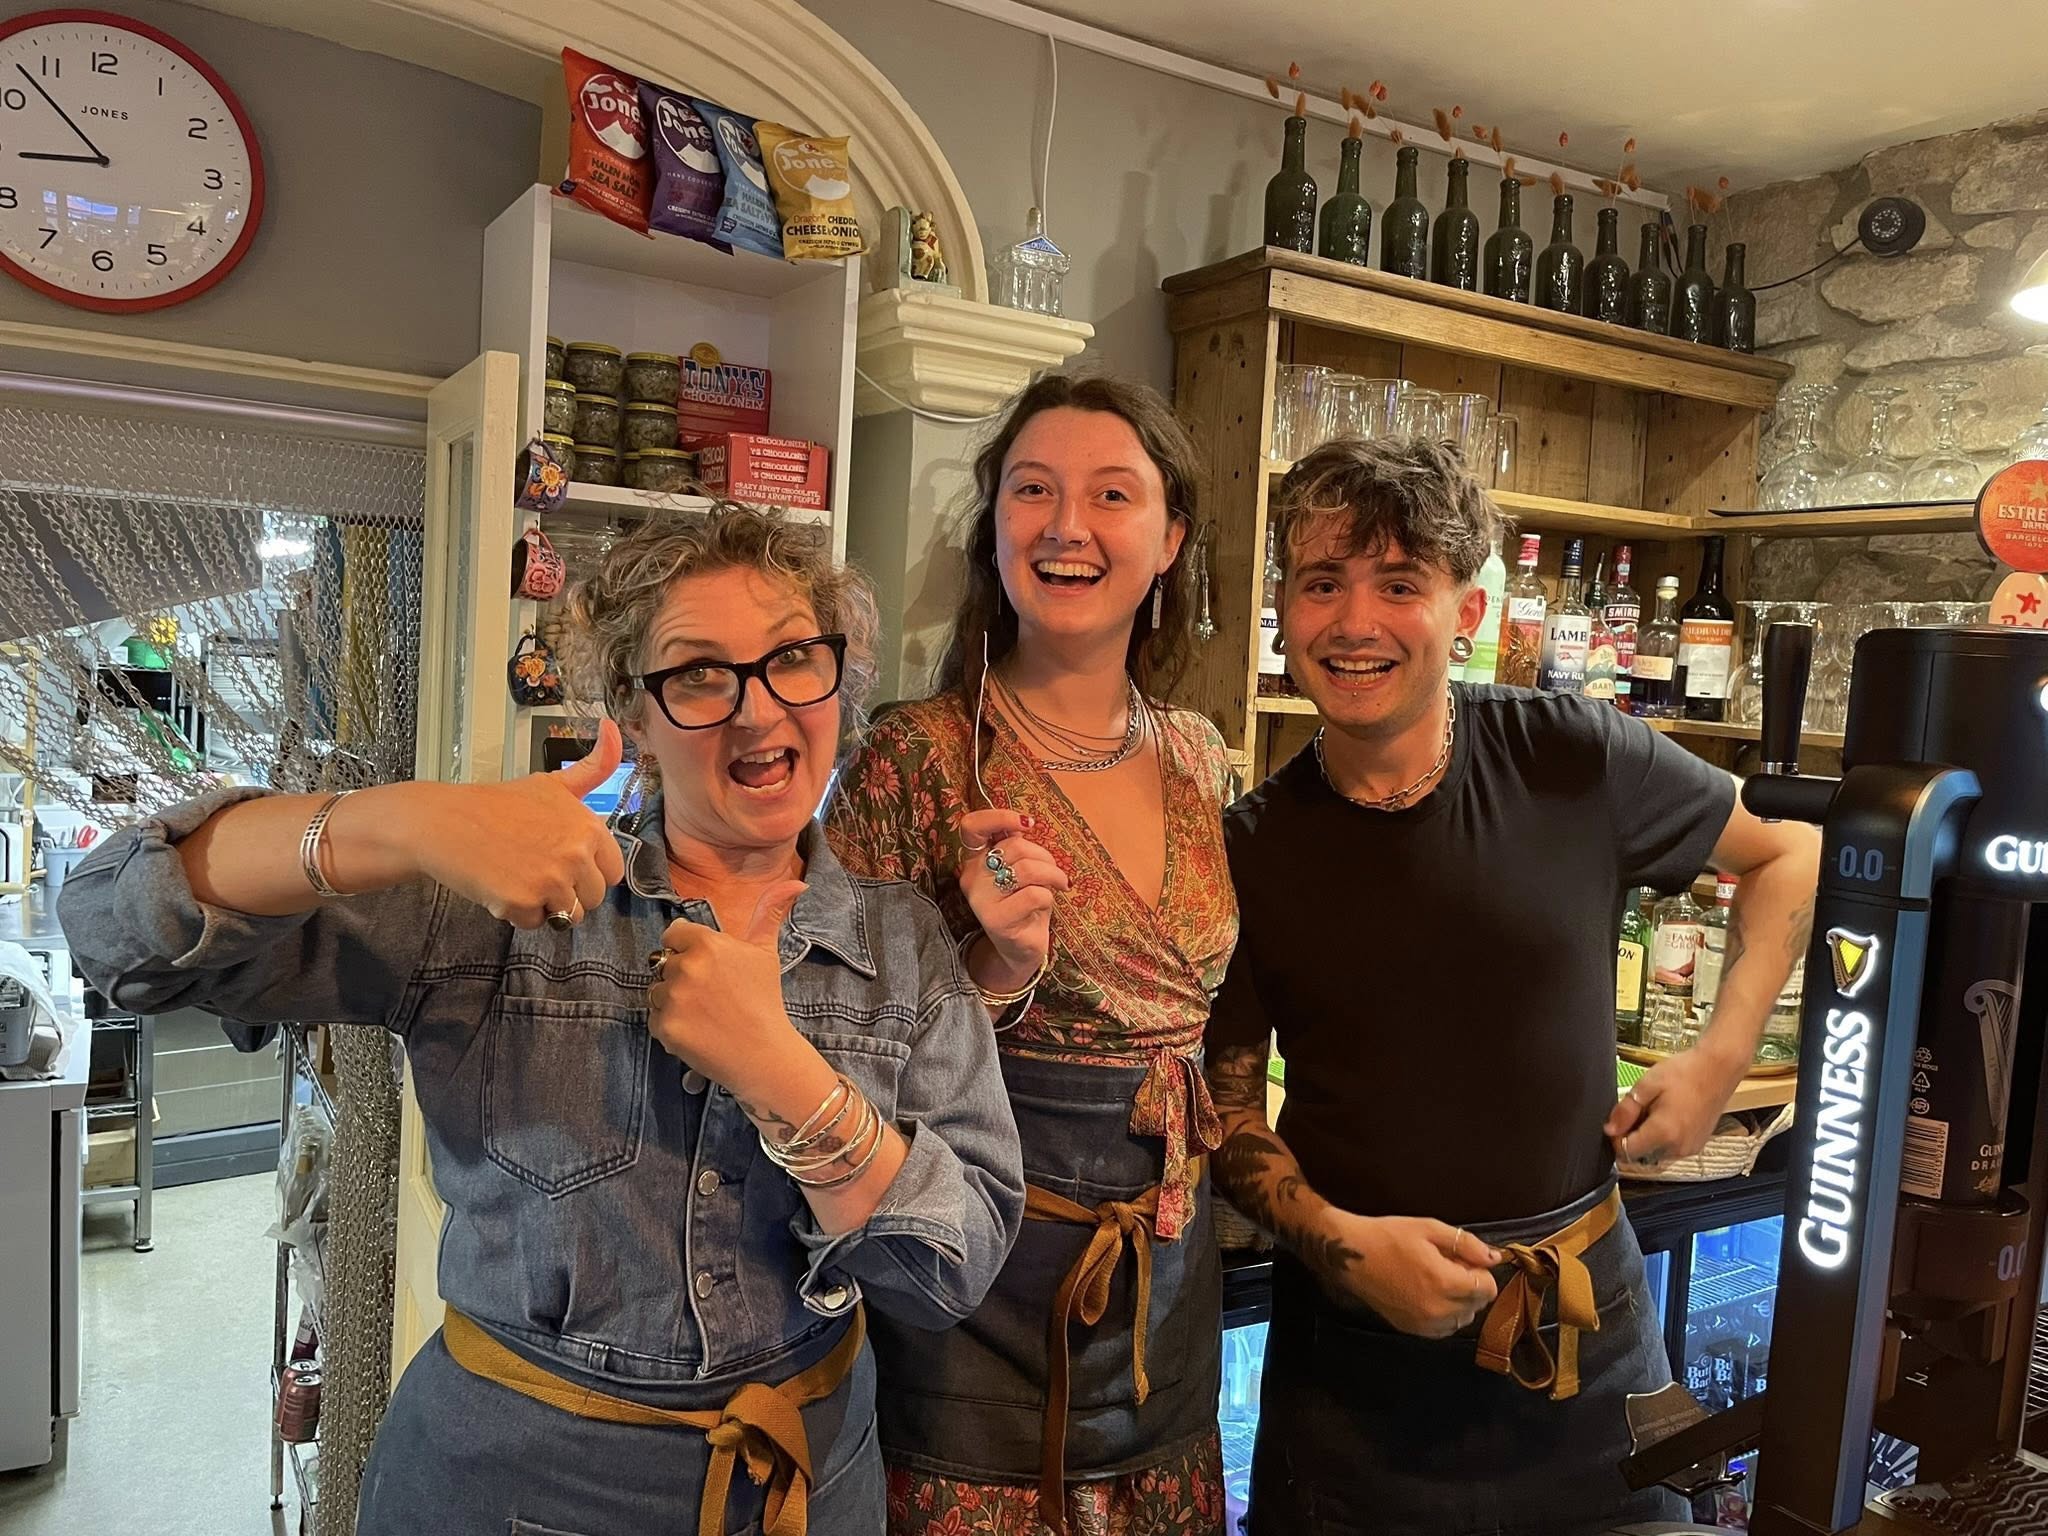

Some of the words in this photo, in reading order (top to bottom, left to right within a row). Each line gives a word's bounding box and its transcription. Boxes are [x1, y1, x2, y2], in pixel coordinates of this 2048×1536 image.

[42, 55, 60, 78] 11
[92, 51, 118, 75] 12
[158, 77, 163, 96] 1
[81, 105, 129, 121] JONES
[587, 93, 642, 123] Jone
[187, 118, 208, 140] 2
[203, 169, 223, 190] 3
[591, 169, 610, 188] SEA
[611, 181, 638, 201] SALT
[0, 187, 19, 209] 8
[186, 216, 207, 236] 4
[786, 225, 827, 236] CHEESE
[38, 228, 58, 249] 7
[91, 250, 114, 272] 6
[147, 244, 167, 265] 5
[682, 388, 766, 410] CHOCOLONELY
[734, 482, 758, 491] CRAZY
[734, 489, 766, 499] SERIOUS
[1998, 504, 2047, 522] ESTRE
[1548, 668, 1571, 680] NAVY
[1839, 844, 1884, 882] 0.0
[1798, 1008, 1872, 1270] GUINNESS
